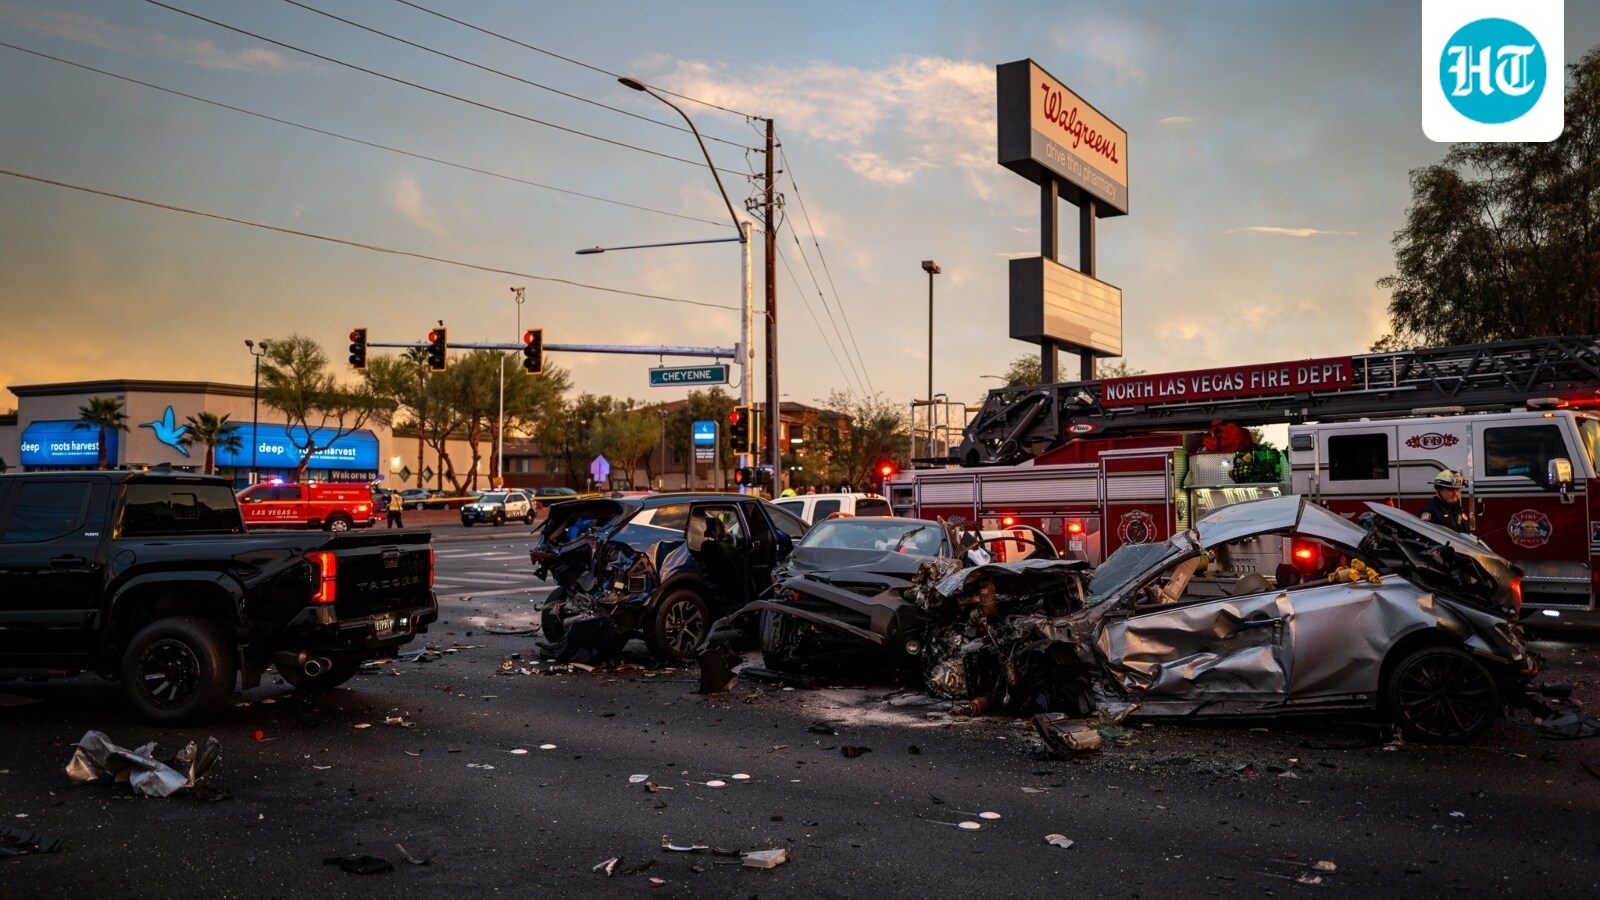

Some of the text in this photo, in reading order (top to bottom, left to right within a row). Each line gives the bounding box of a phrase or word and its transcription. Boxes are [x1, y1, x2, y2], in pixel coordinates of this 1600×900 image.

[1041, 83, 1118, 164] Walgreens
[1046, 142, 1117, 200] drive thru pharmacy
[662, 370, 712, 381] CHEYENNE
[1106, 364, 1347, 401] NORTH LAS VEGAS FIRE DEPT.
[21, 440, 100, 453] deep roots harvest
[258, 442, 284, 455] deep
[332, 470, 376, 480] Welcome to
